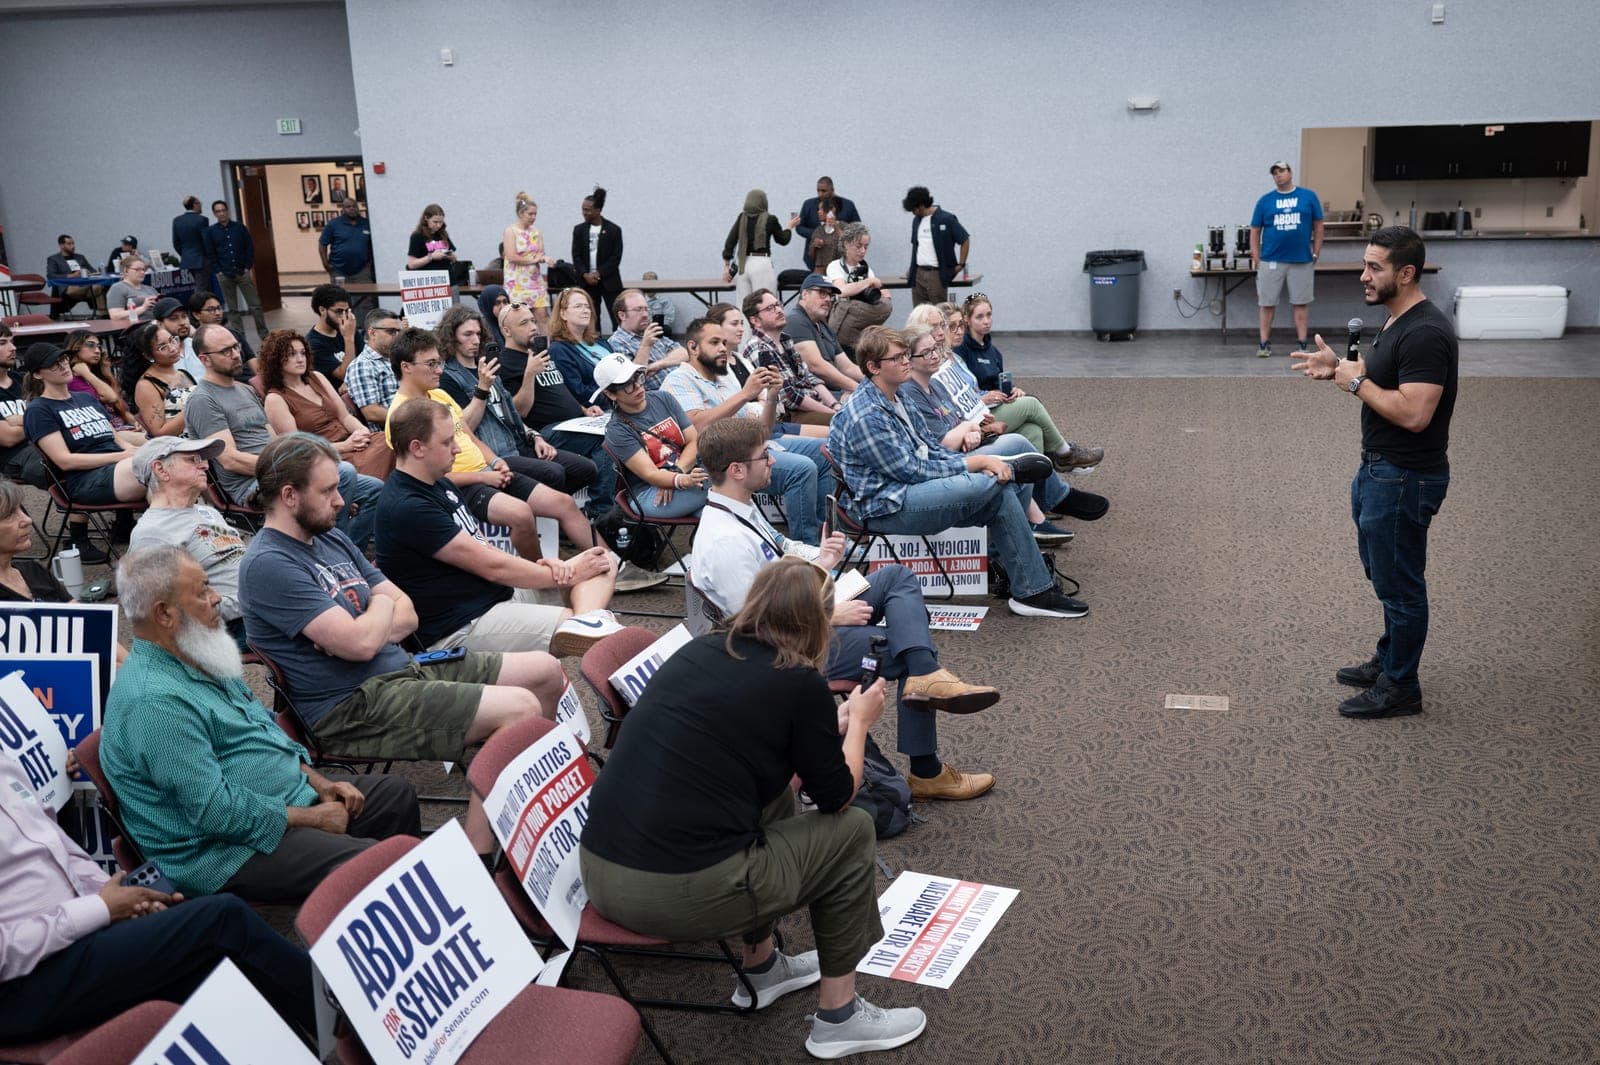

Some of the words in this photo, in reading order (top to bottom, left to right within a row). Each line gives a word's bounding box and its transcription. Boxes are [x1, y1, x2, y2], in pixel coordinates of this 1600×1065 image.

[280, 119, 296, 132] EXIT
[1276, 197, 1298, 208] UAW
[1274, 212, 1301, 226] ABDUL
[431, 275, 447, 285] POLITICS
[406, 300, 430, 315] MEDICARE
[431, 299, 441, 313] FOR
[58, 405, 107, 429] ABDUL
[899, 542, 920, 558] FOR
[911, 561, 935, 572] YOUR
[950, 559, 981, 571] MONEY
[931, 575, 947, 587] OUT
[950, 573, 981, 585] MONEY
[512, 778, 529, 802] OF
[522, 741, 571, 787] POLITICS
[525, 801, 549, 836] YOUR
[541, 765, 586, 815] POCKET
[528, 841, 559, 908] MEDICARE
[548, 819, 580, 860] FOR
[898, 881, 953, 929] MEDICARE
[958, 915, 982, 933] OUT
[336, 860, 467, 1012] ABDUL
[881, 928, 917, 950] FOR
[950, 931, 972, 945] OF
[866, 948, 901, 969] ALL
[900, 945, 931, 974] POCKET
[924, 942, 963, 980] POLITICS
[395, 922, 496, 1041] SENATE
[382, 1007, 403, 1040] FOR
[395, 1022, 418, 1060] US
